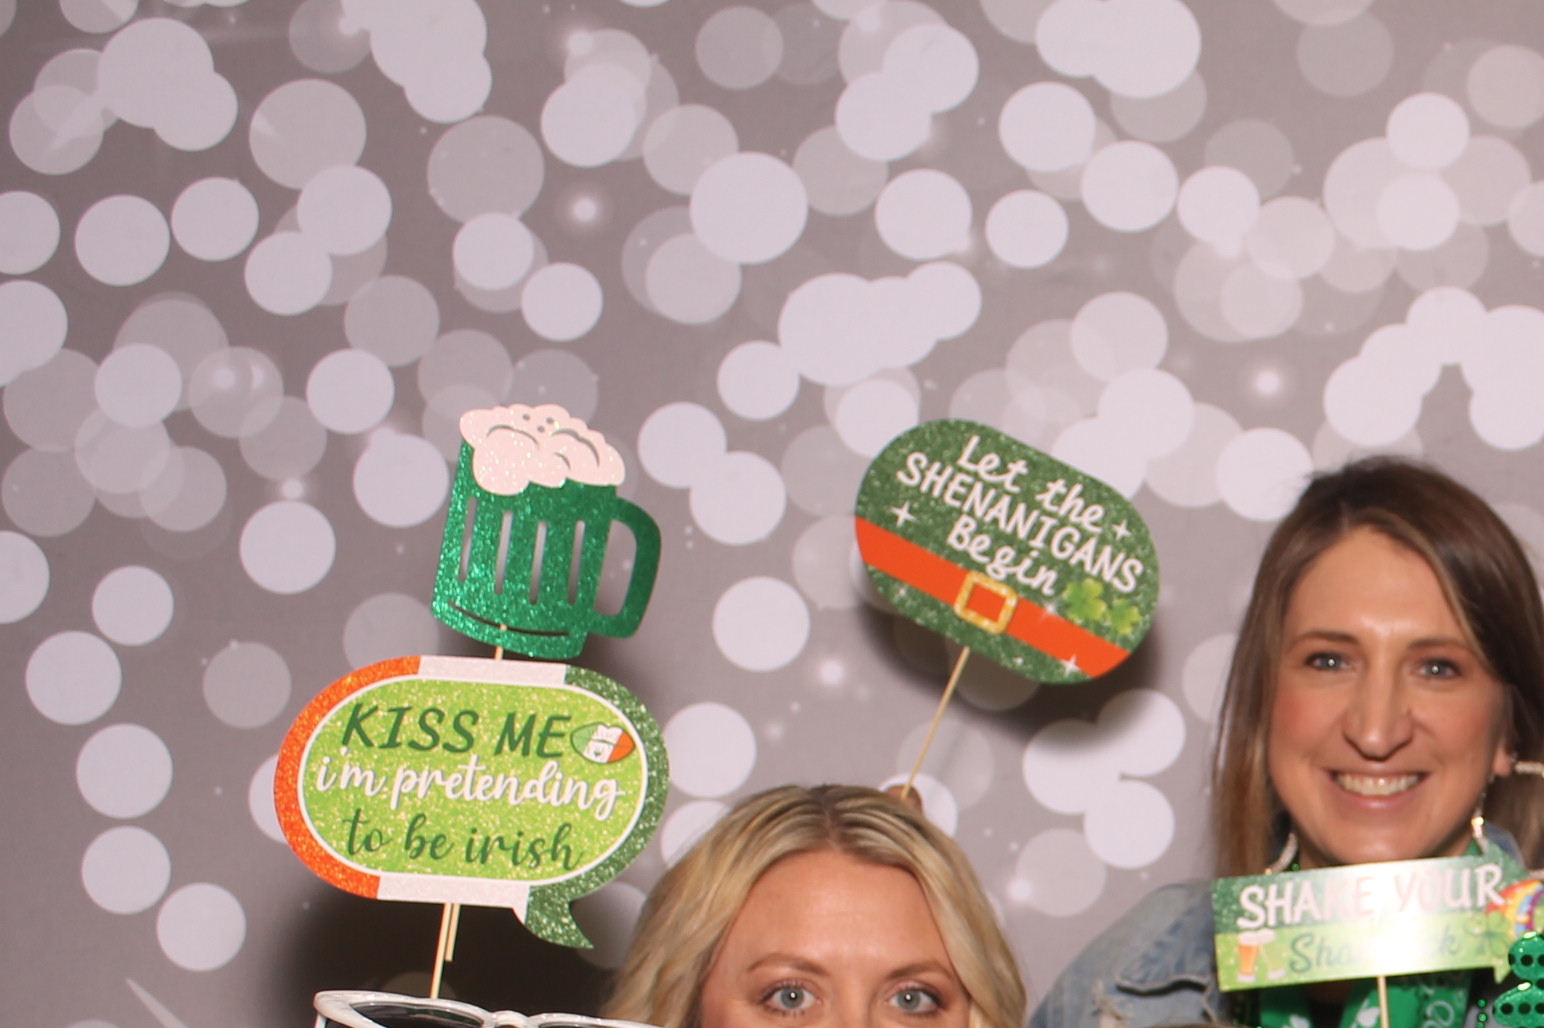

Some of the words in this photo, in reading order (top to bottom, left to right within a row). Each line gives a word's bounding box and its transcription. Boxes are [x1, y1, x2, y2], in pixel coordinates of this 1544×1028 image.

[957, 435, 1029, 493] Let
[1035, 478, 1106, 533] the
[896, 451, 1144, 593] SHENANIGANS
[946, 514, 1060, 595] Begin
[341, 703, 479, 754] KISS
[494, 712, 572, 758] ME
[389, 754, 626, 821] pretending
[342, 808, 393, 856] to
[404, 813, 454, 860] be
[465, 822, 585, 871] irish
[1236, 874, 1379, 929] SHAKE
[1394, 863, 1506, 913] YOUR
